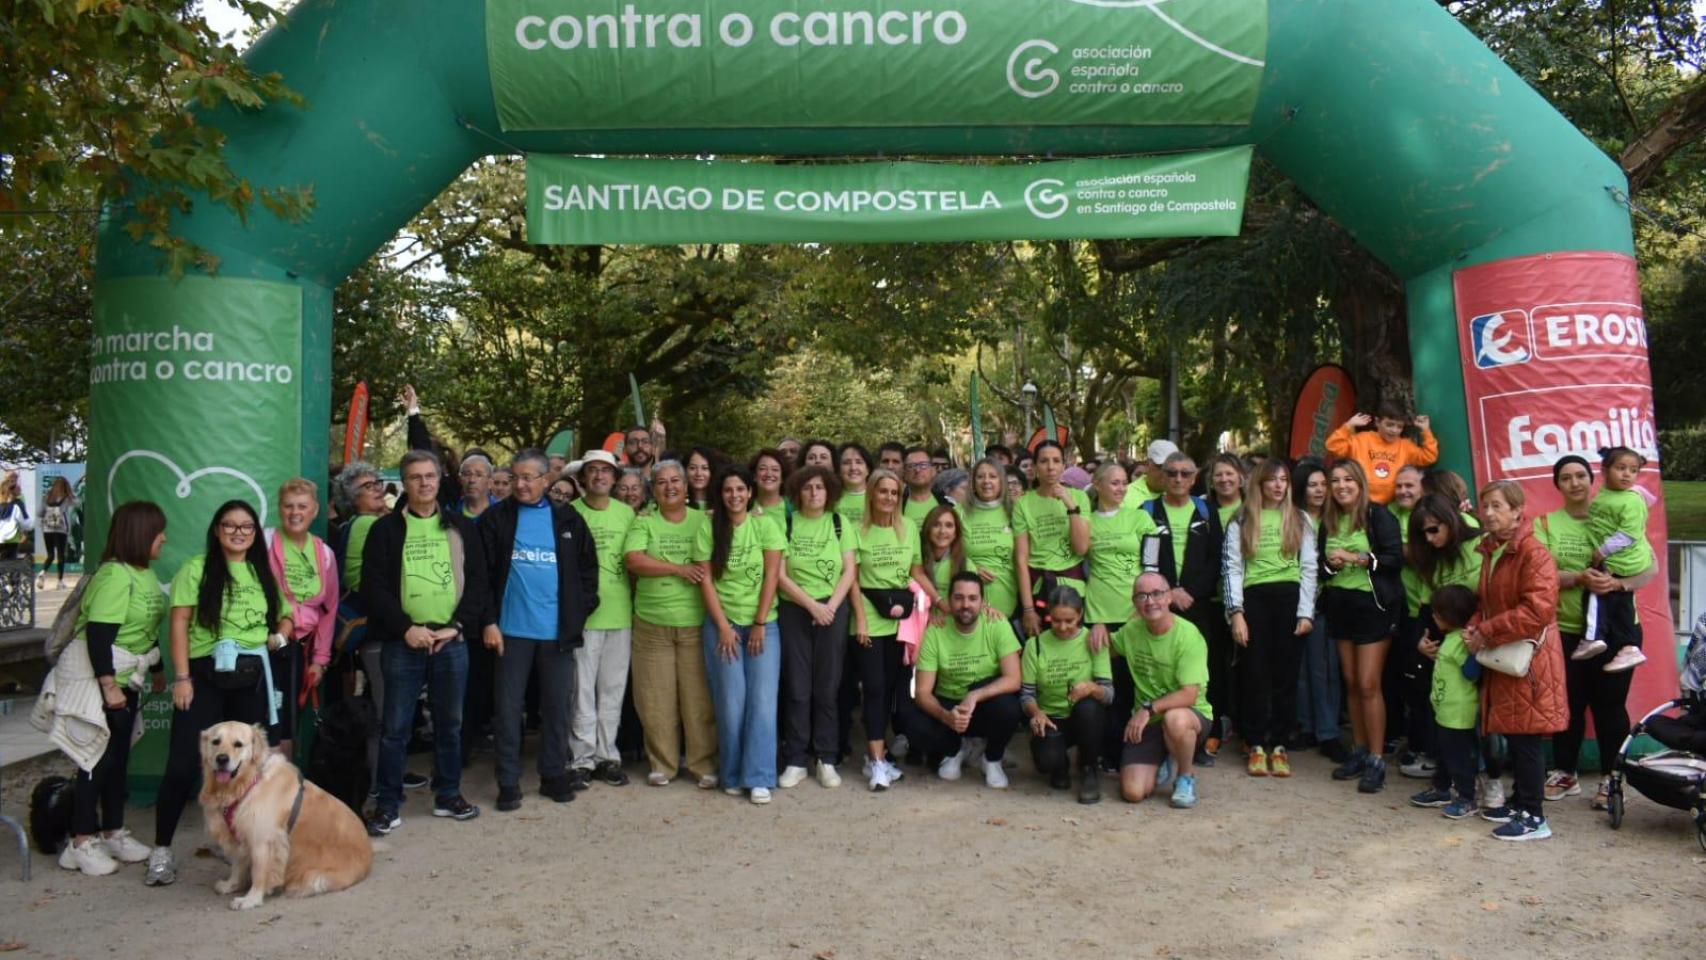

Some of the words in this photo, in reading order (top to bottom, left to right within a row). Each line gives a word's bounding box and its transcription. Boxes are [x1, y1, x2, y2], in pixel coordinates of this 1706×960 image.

[515, 4, 701, 50] contra
[719, 12, 754, 47] o
[770, 10, 967, 47] cancro
[1072, 45, 1152, 59] asociación
[1071, 63, 1139, 79] española
[1069, 81, 1117, 93] contra
[1120, 82, 1131, 93] o
[1133, 82, 1184, 93] cancro
[1076, 174, 1141, 187] asociación
[1143, 171, 1197, 186] española
[544, 184, 712, 210] SANTIAGO
[722, 188, 766, 211] DE
[773, 190, 1002, 212] COMPOSTELA
[1076, 189, 1116, 200] contra
[1118, 190, 1126, 199] o
[1128, 188, 1168, 199] cancro
[1076, 205, 1092, 214] en
[1094, 202, 1147, 215] Santiago
[1149, 200, 1164, 212] de
[1166, 199, 1237, 213] Compostela
[106, 325, 214, 353] marcha
[155, 360, 174, 380] o
[184, 359, 293, 384] cancro
[143, 719, 171, 729] con
